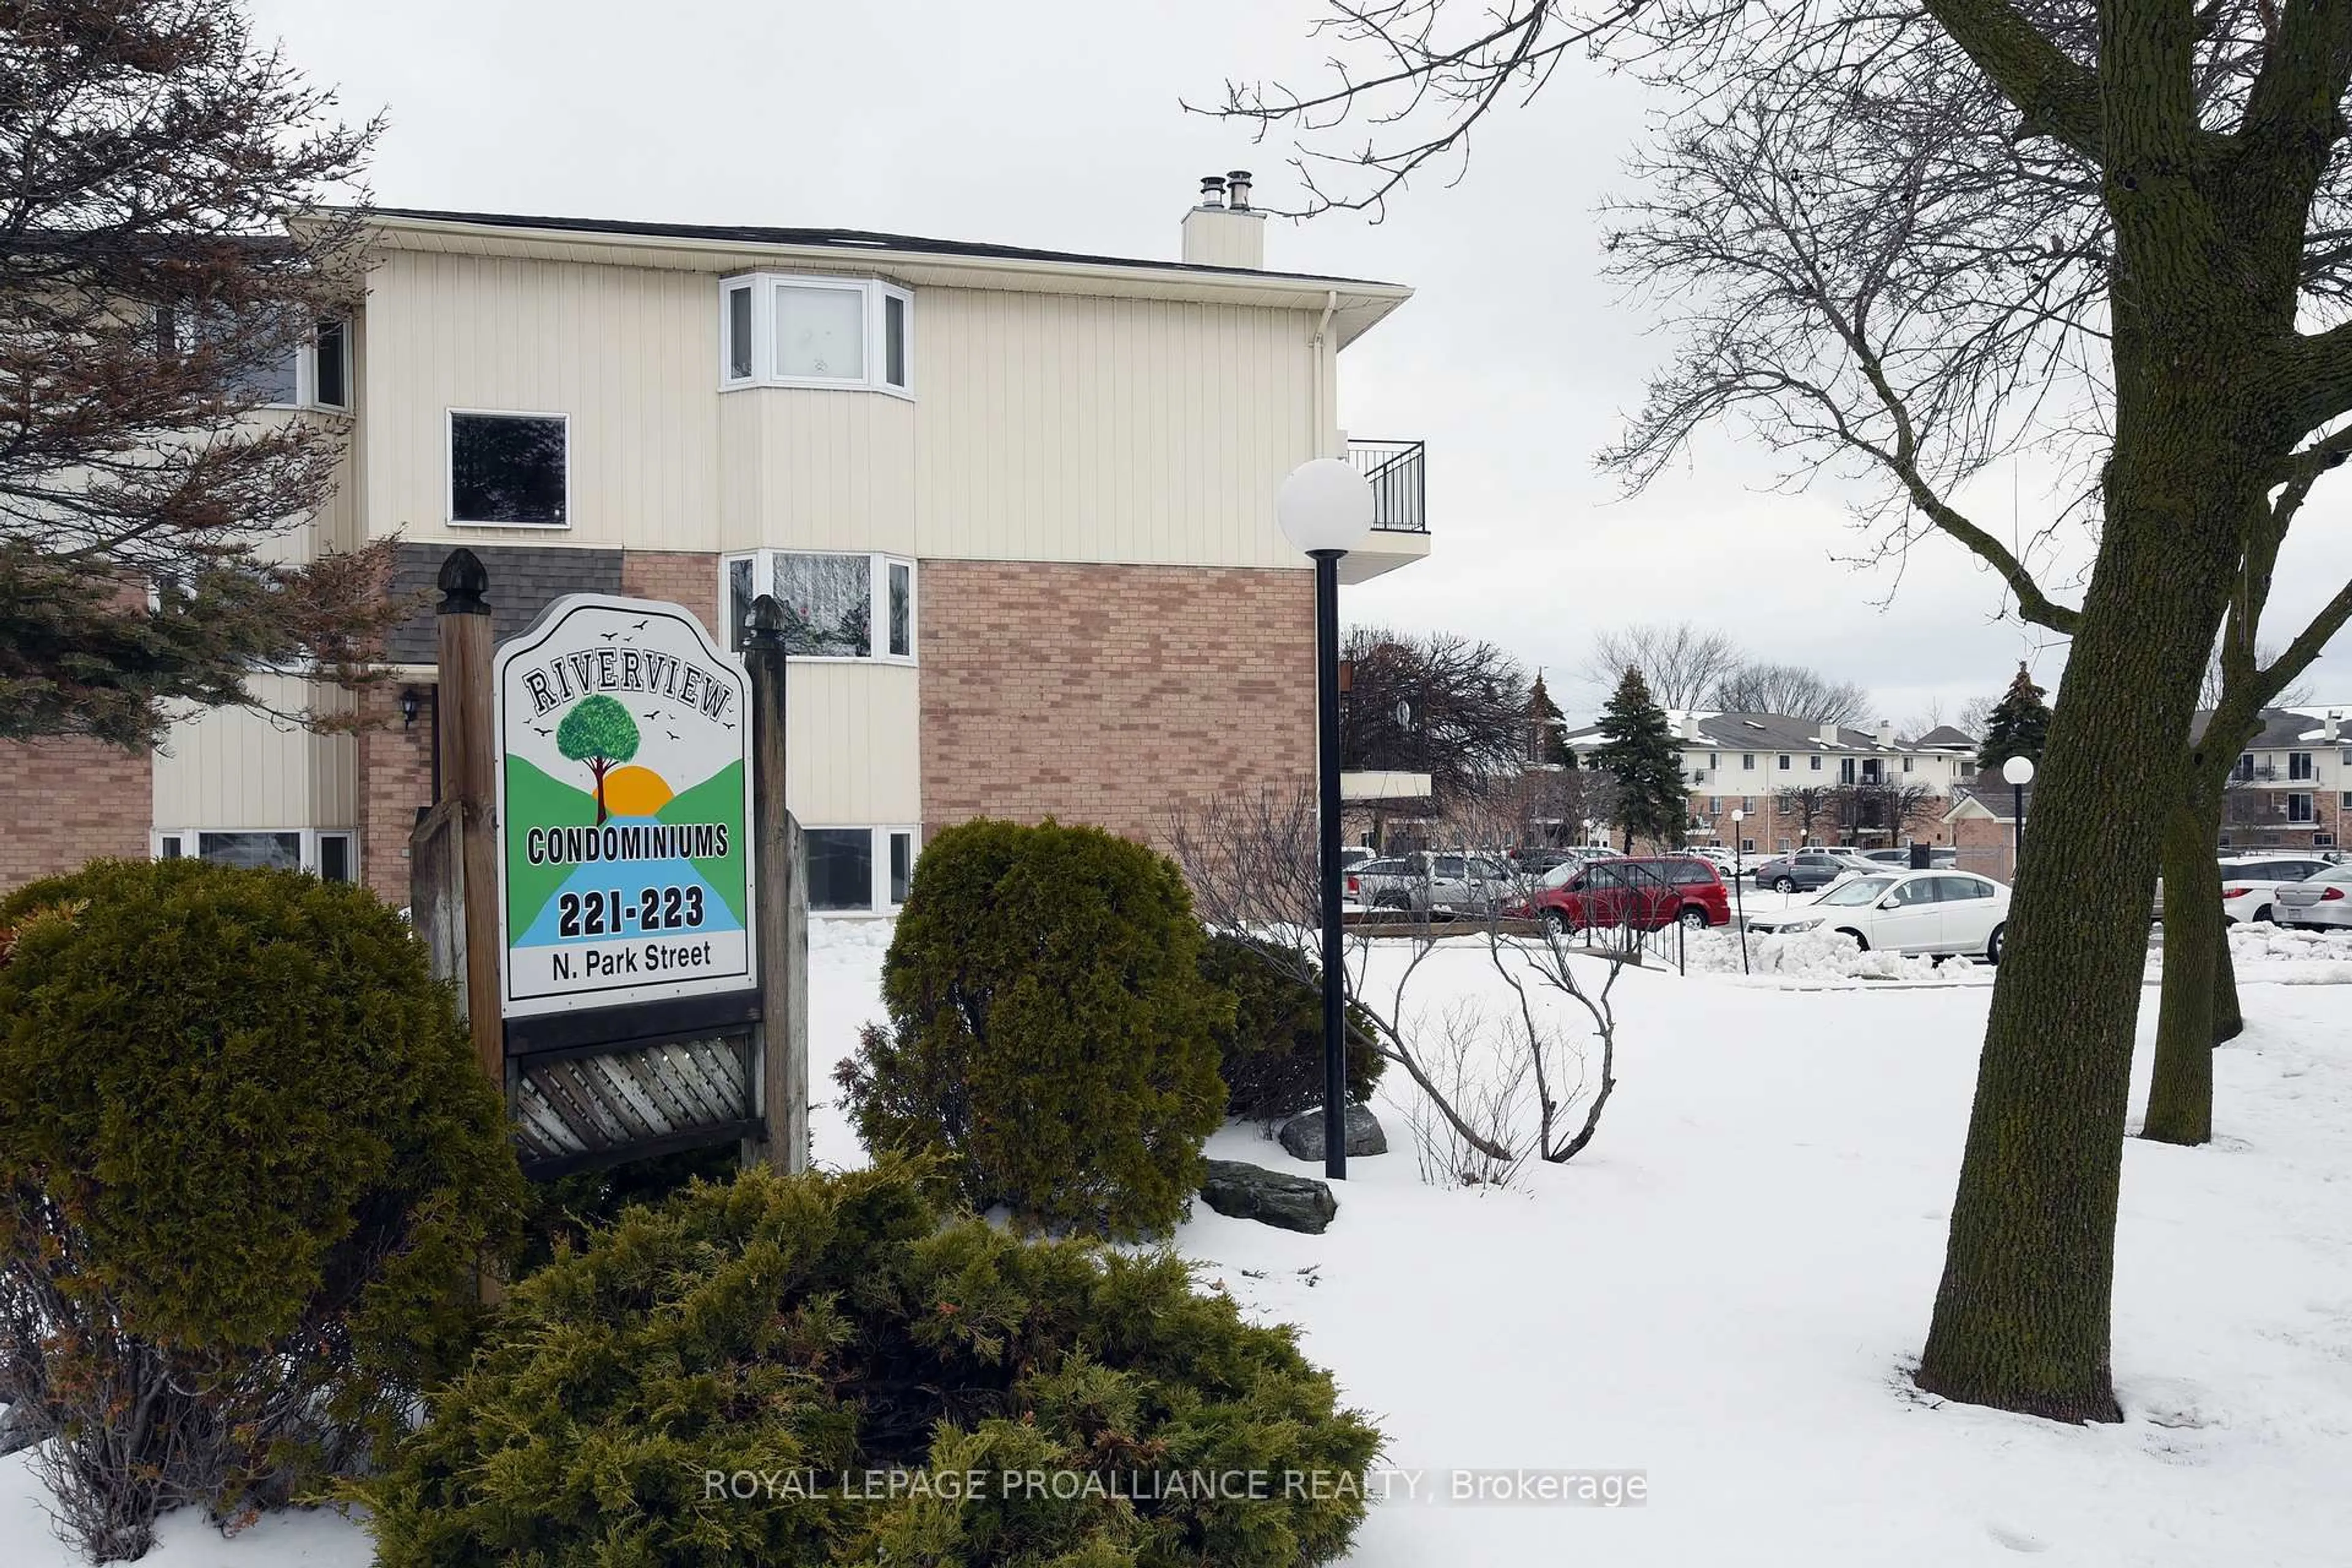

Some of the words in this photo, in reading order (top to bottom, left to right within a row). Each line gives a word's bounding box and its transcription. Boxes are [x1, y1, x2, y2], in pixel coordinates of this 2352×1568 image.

[523, 647, 732, 722] RIVERVIEW
[527, 823, 729, 865] CONDOMINIUMS
[559, 886, 705, 938] 221-223
[552, 953, 577, 981] N.
[586, 947, 638, 977] Park
[645, 941, 710, 971] Street
